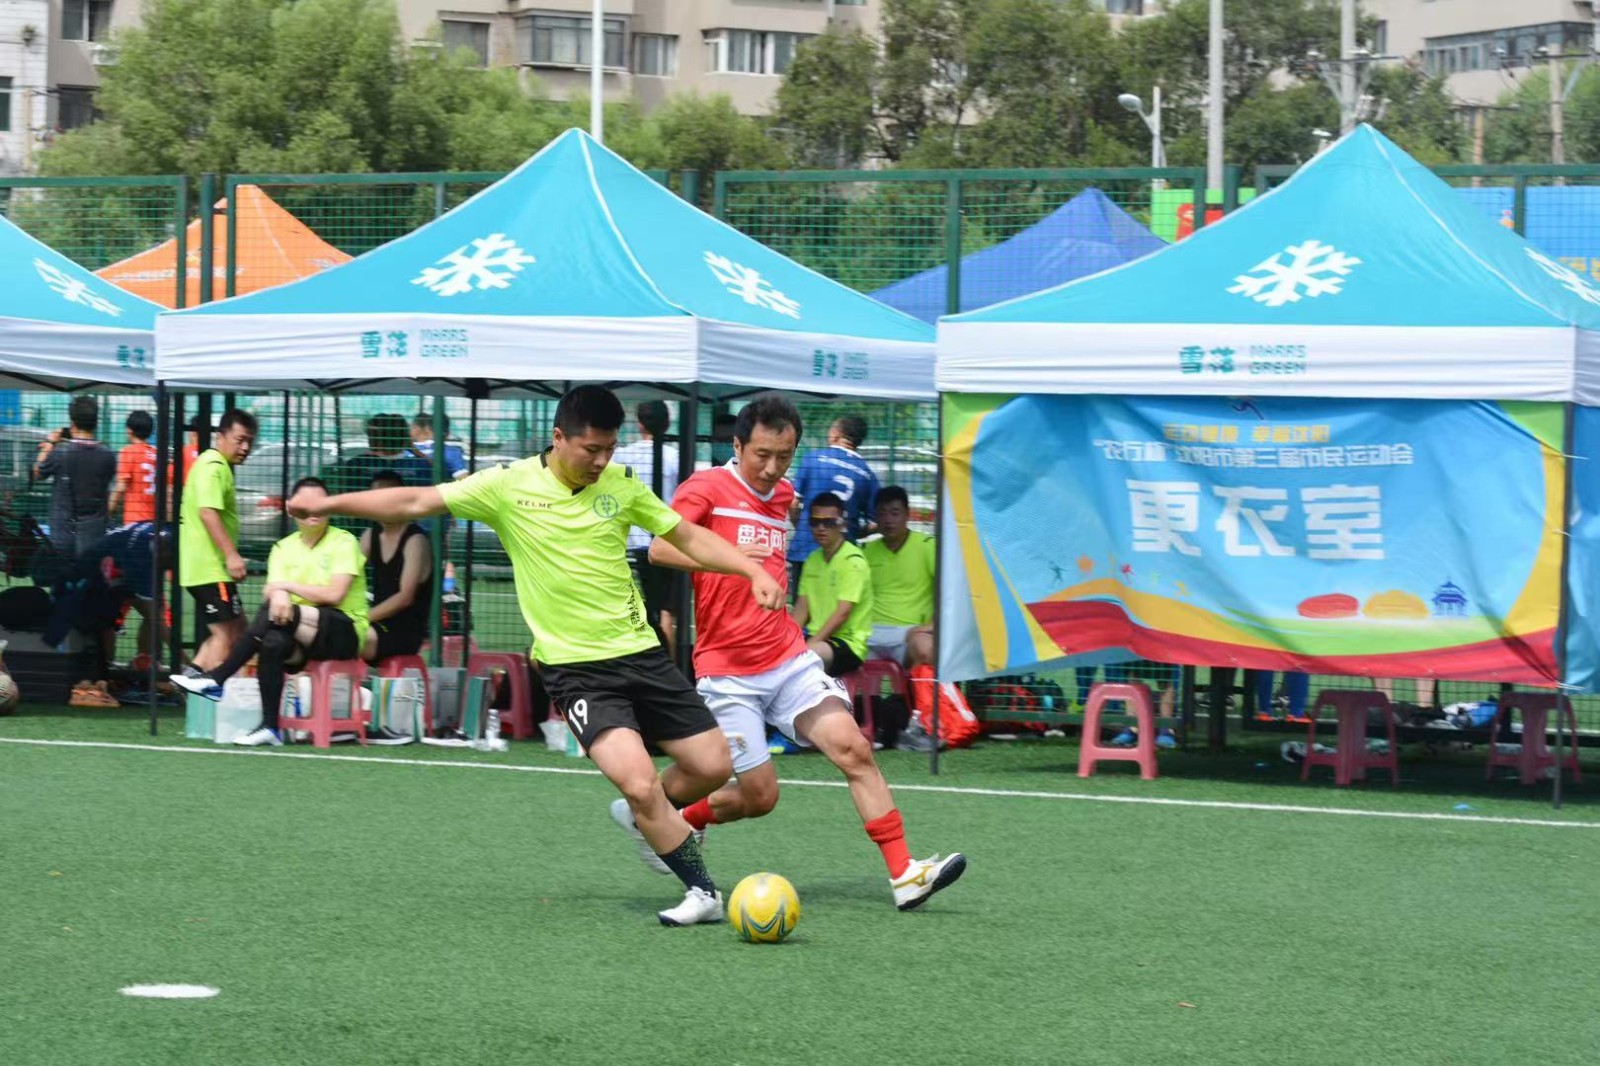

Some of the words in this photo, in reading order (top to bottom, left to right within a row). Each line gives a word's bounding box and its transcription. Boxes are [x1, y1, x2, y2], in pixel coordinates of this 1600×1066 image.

[420, 344, 468, 357] GREEN
[1248, 361, 1307, 374] GREEN
[517, 499, 553, 509] KELME
[1126, 479, 1385, 560] 更衣室
[569, 699, 588, 734] 19
